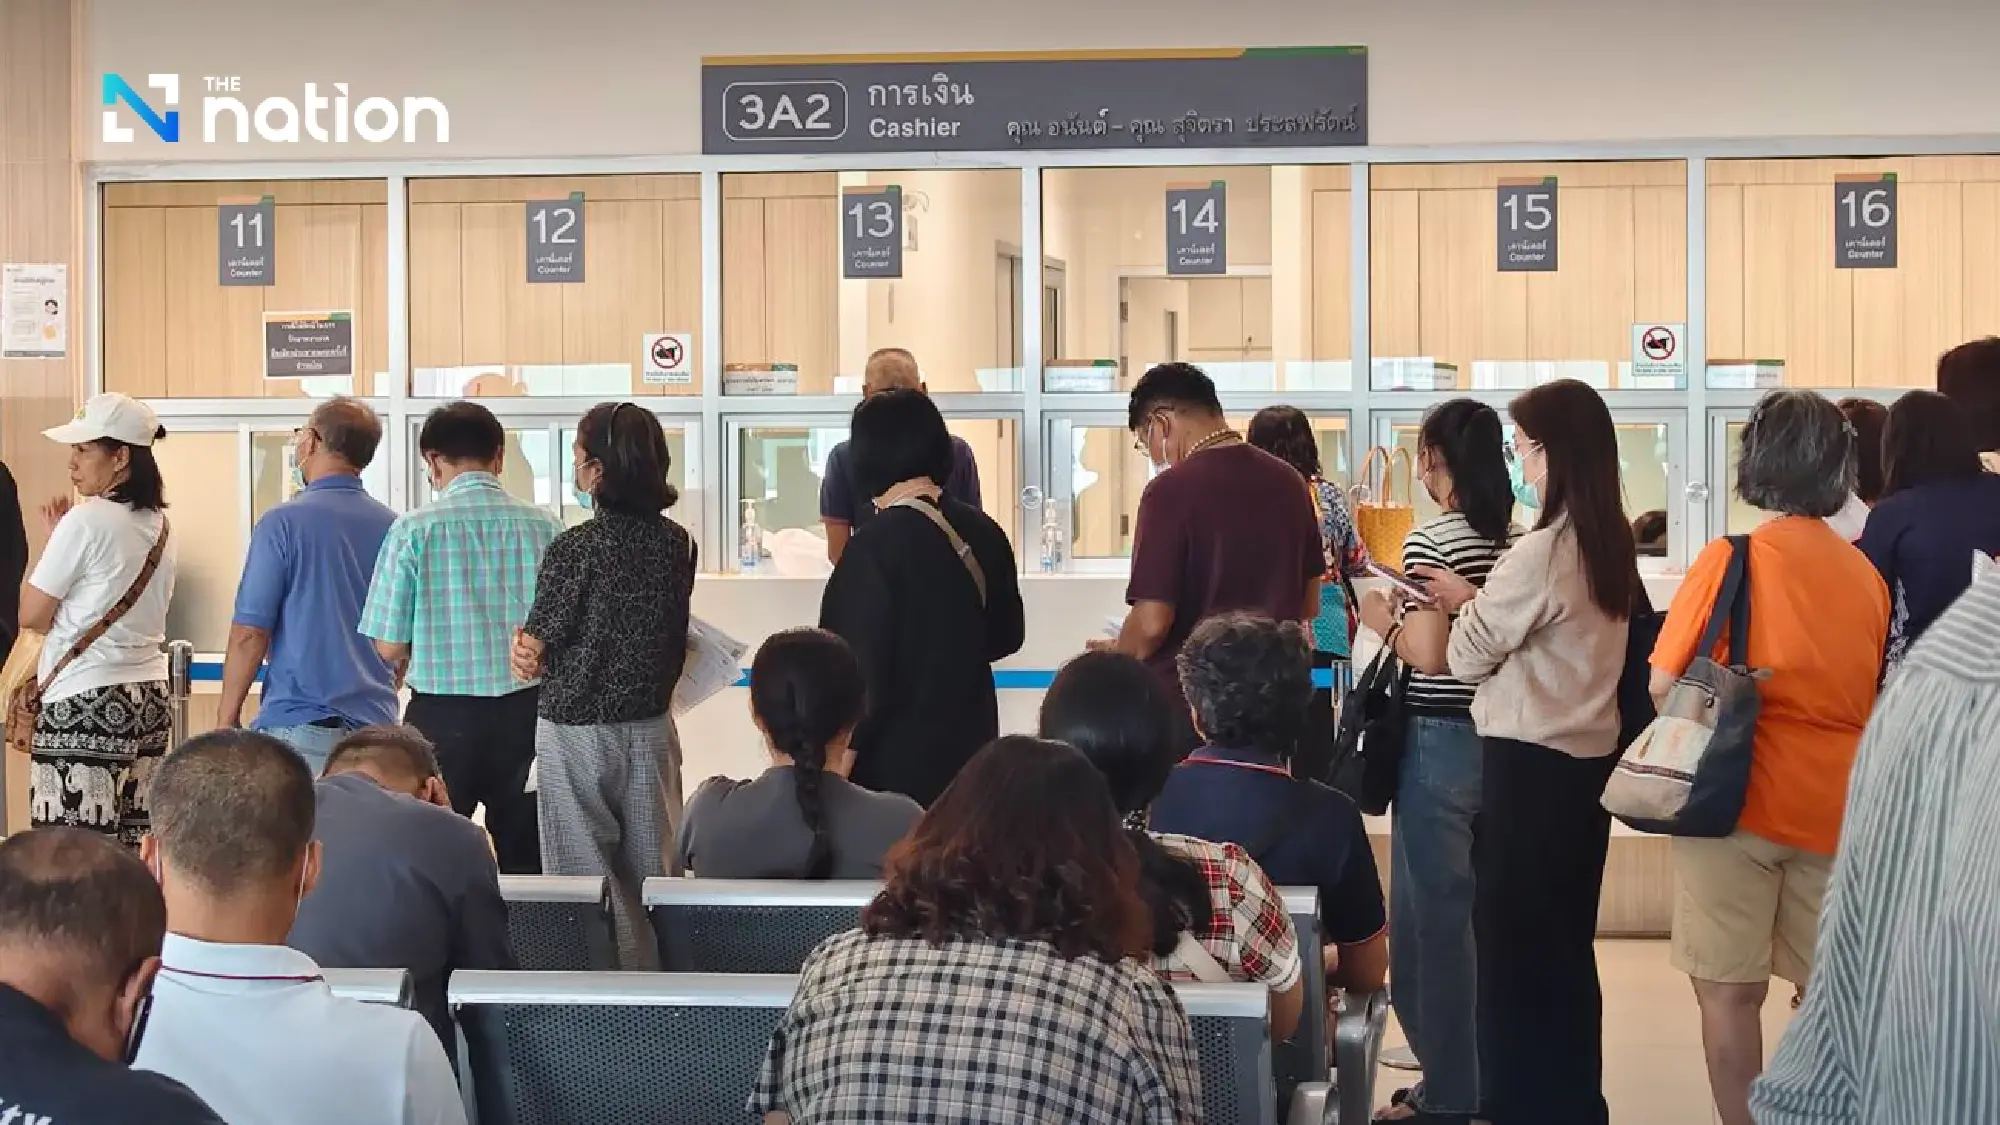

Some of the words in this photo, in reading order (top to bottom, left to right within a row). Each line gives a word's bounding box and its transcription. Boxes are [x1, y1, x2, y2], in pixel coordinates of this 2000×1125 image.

[867, 71, 975, 105] การเงิน
[739, 94, 833, 130] 3A2
[870, 116, 961, 138] Cashier
[1007, 120, 1042, 143] คุณ
[1131, 119, 1166, 143] คุณ
[848, 201, 894, 238] 13
[1172, 198, 1219, 235] 14
[1503, 194, 1552, 231] 15
[1841, 190, 1890, 227] 16
[230, 212, 263, 248] 11
[533, 208, 577, 244] 12
[854, 259, 888, 268] Counter
[1179, 256, 1214, 266] Counter
[1509, 252, 1546, 262] Counter
[1848, 249, 1885, 260] Counter
[230, 268, 263, 278] Counter
[537, 265, 571, 274] Counter
